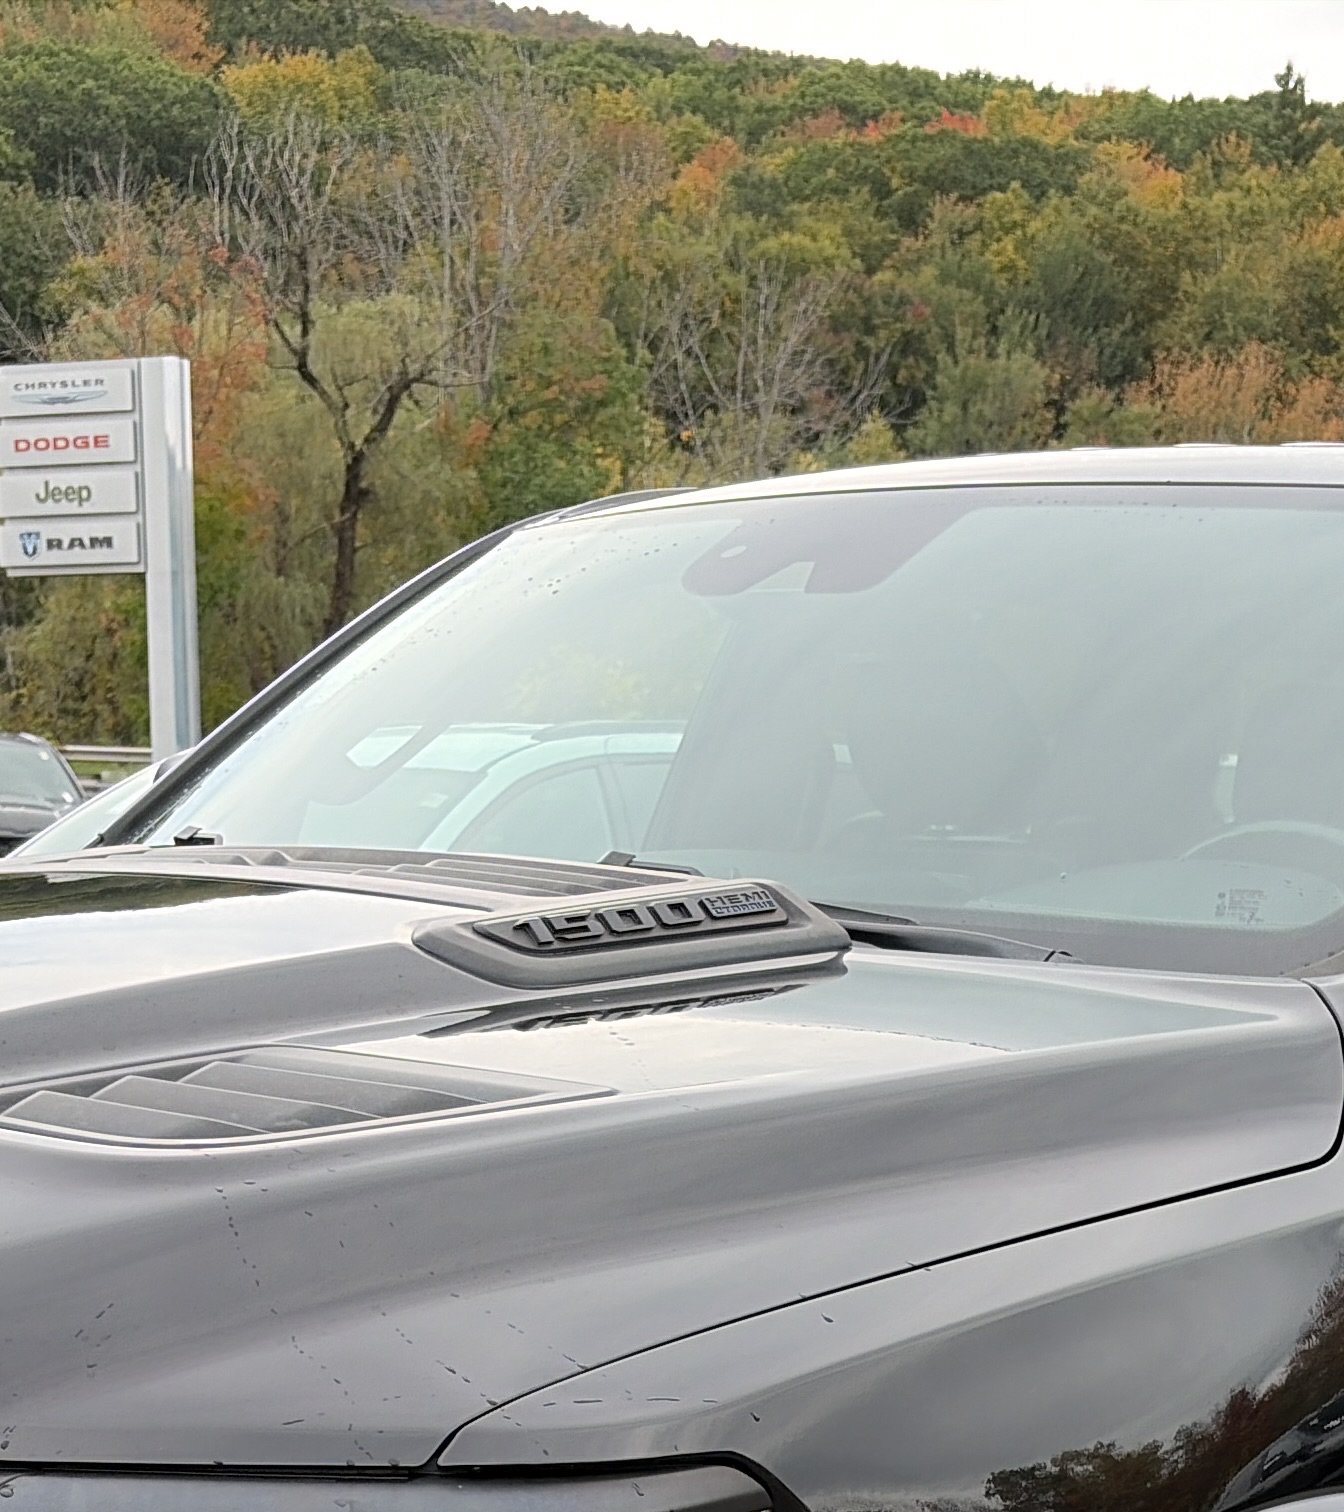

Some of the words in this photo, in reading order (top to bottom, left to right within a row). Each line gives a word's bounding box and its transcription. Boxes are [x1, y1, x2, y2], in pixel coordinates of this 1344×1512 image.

[13, 379, 105, 392] CHRYSLER
[14, 435, 111, 453] DODGE
[35, 480, 92, 507] Jeep
[45, 536, 114, 551] RAM
[704, 890, 771, 907] HEMI
[513, 898, 706, 945] 1500
